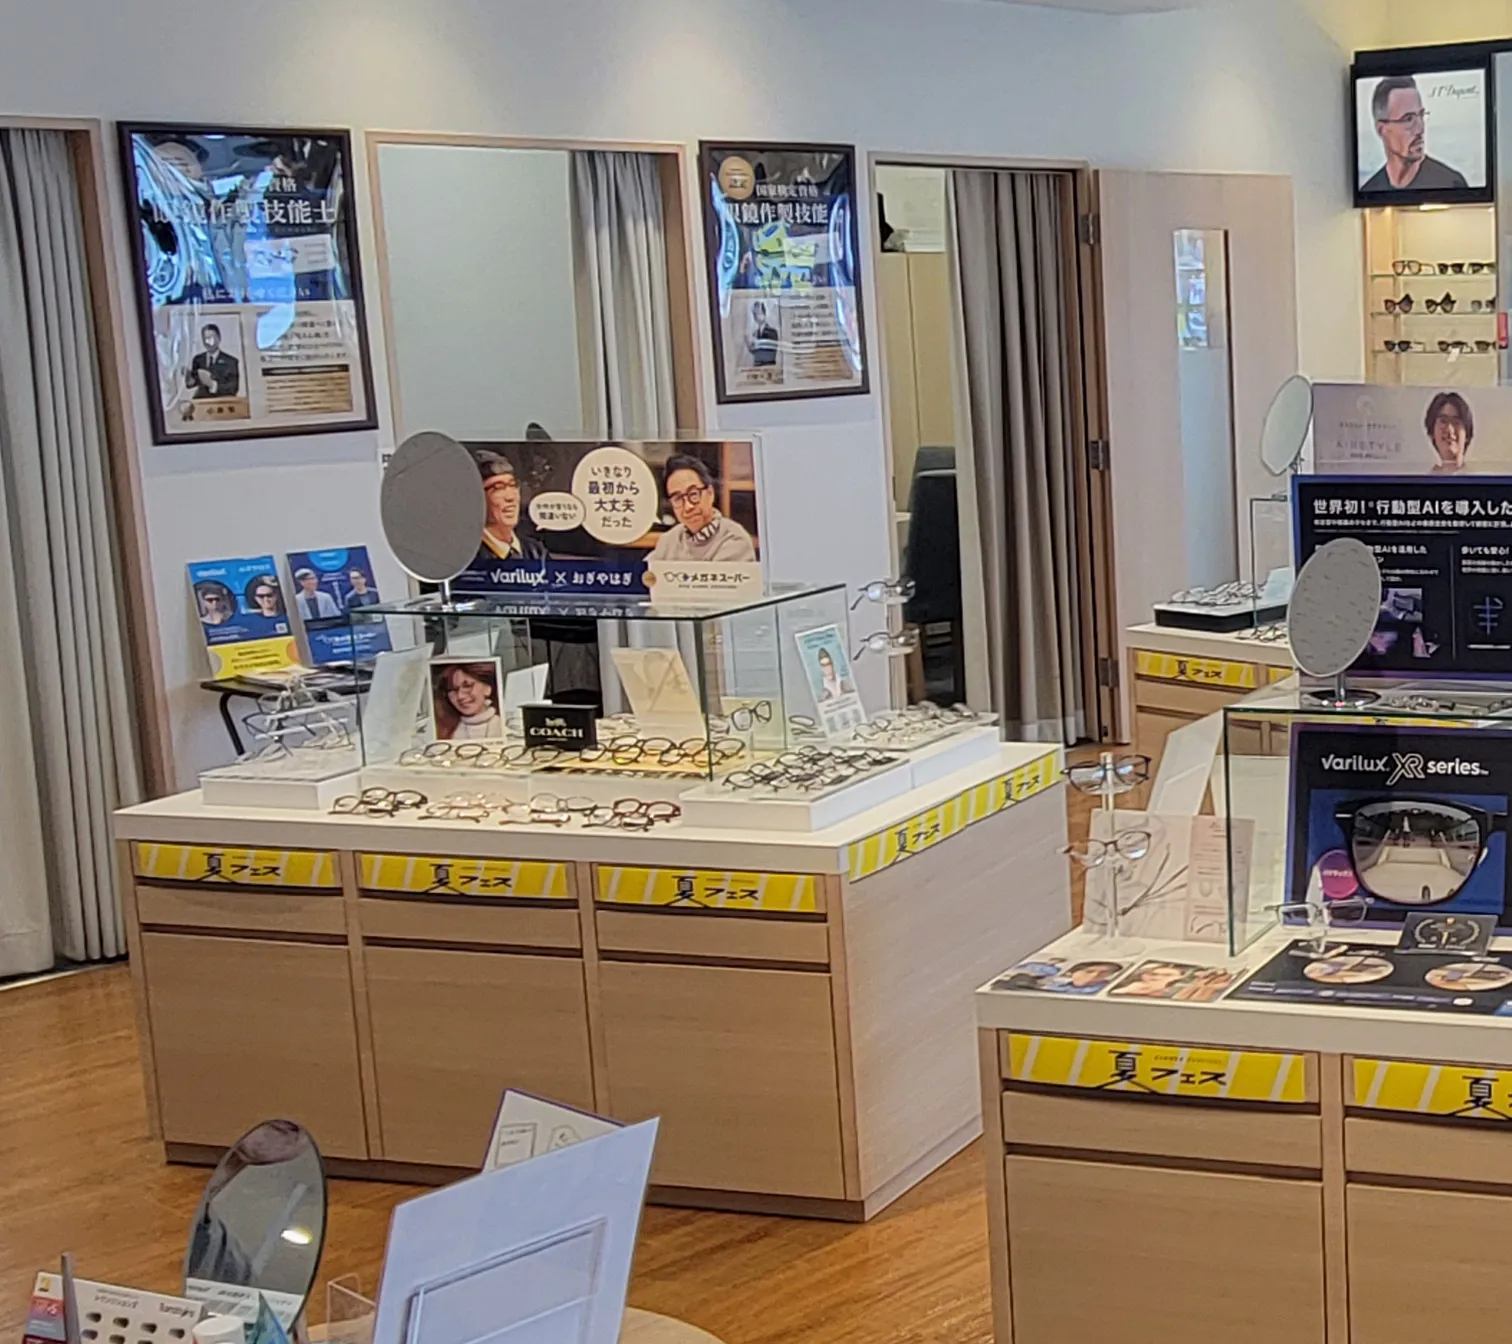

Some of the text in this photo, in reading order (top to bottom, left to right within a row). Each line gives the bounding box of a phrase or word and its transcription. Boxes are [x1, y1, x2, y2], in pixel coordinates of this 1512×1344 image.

[590, 466, 632, 478] いきなり
[588, 481, 640, 496] 最初から
[594, 499, 636, 513] 大丈夫
[601, 515, 633, 528] だった
[490, 568, 547, 586] Varilux
[690, 571, 751, 584] メガネスーパー
[529, 727, 584, 738] COACH
[1321, 755, 1386, 774] Varilux
[1427, 759, 1481, 777] series
[198, 853, 281, 882] 夏フェス
[424, 864, 512, 894] 夏フェス
[667, 875, 759, 906] 夏フェス
[1096, 1049, 1228, 1093] 夏フェス
